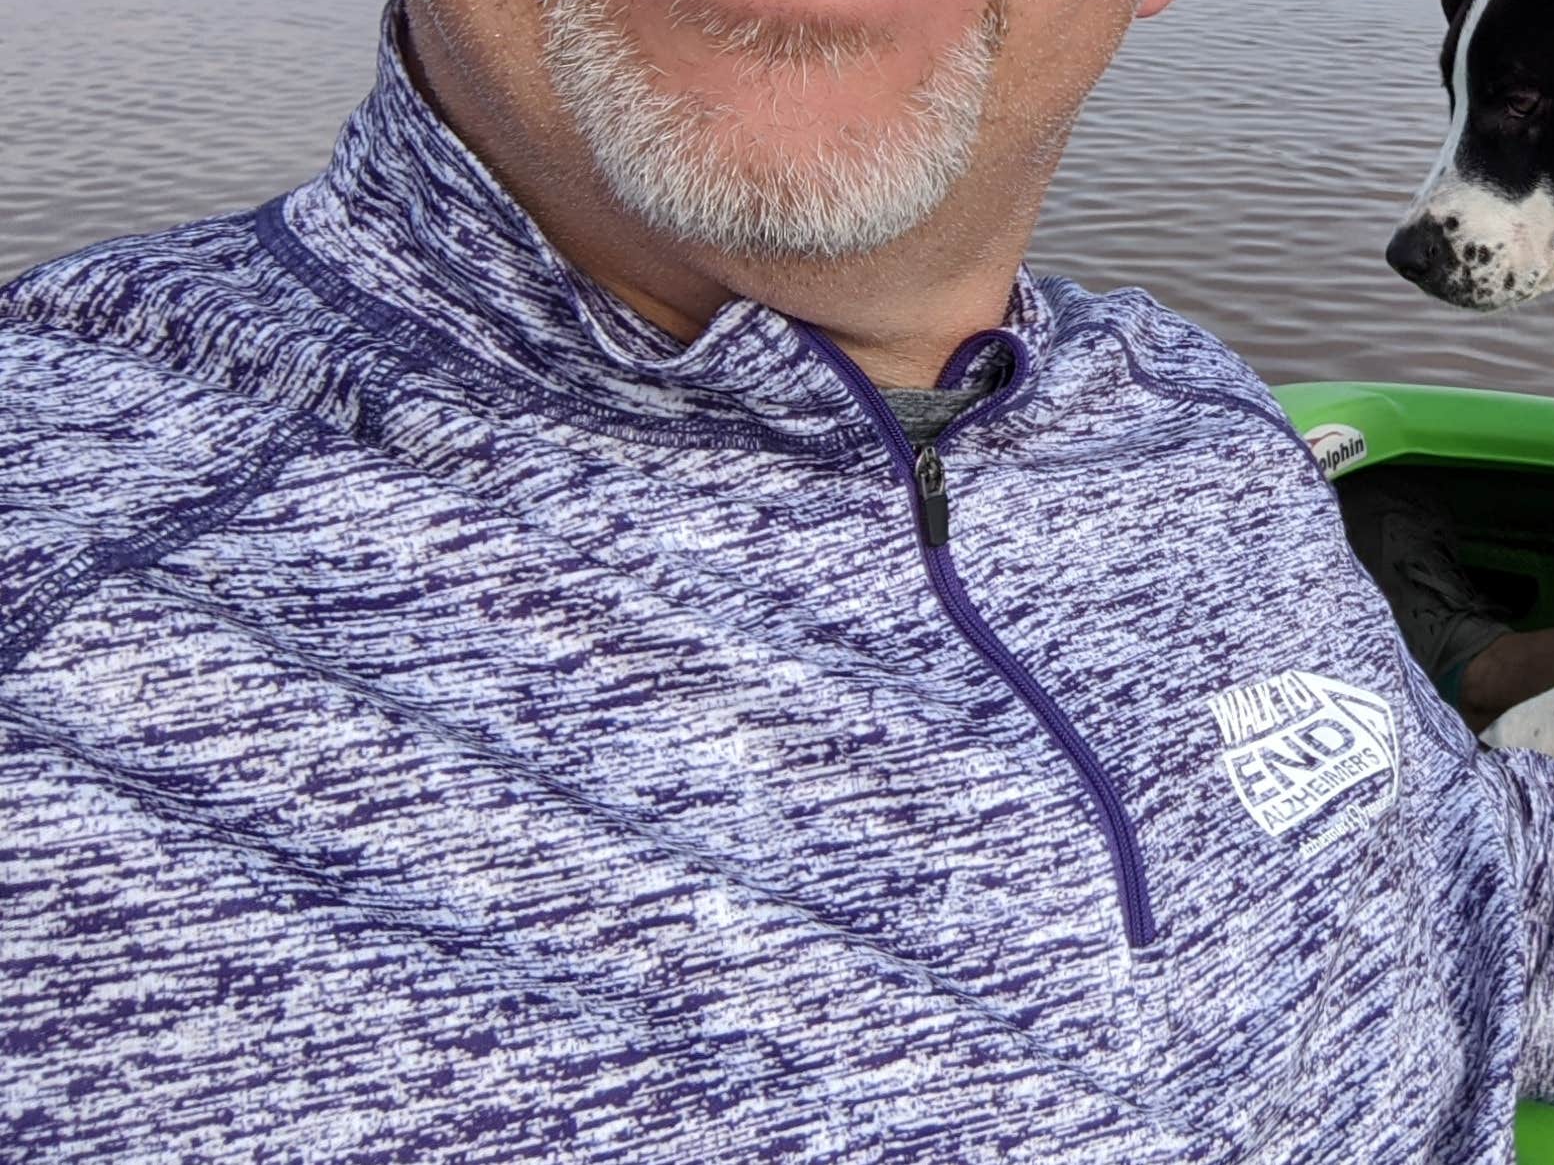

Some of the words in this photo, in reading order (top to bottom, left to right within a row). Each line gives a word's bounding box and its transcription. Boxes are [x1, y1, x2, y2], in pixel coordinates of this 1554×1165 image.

[1319, 438, 1364, 471] olphin
[1208, 682, 1283, 745] WALK
[1268, 670, 1314, 717] TO
[1231, 718, 1356, 808] END
[1262, 747, 1380, 831] ALZHEIMER'S
